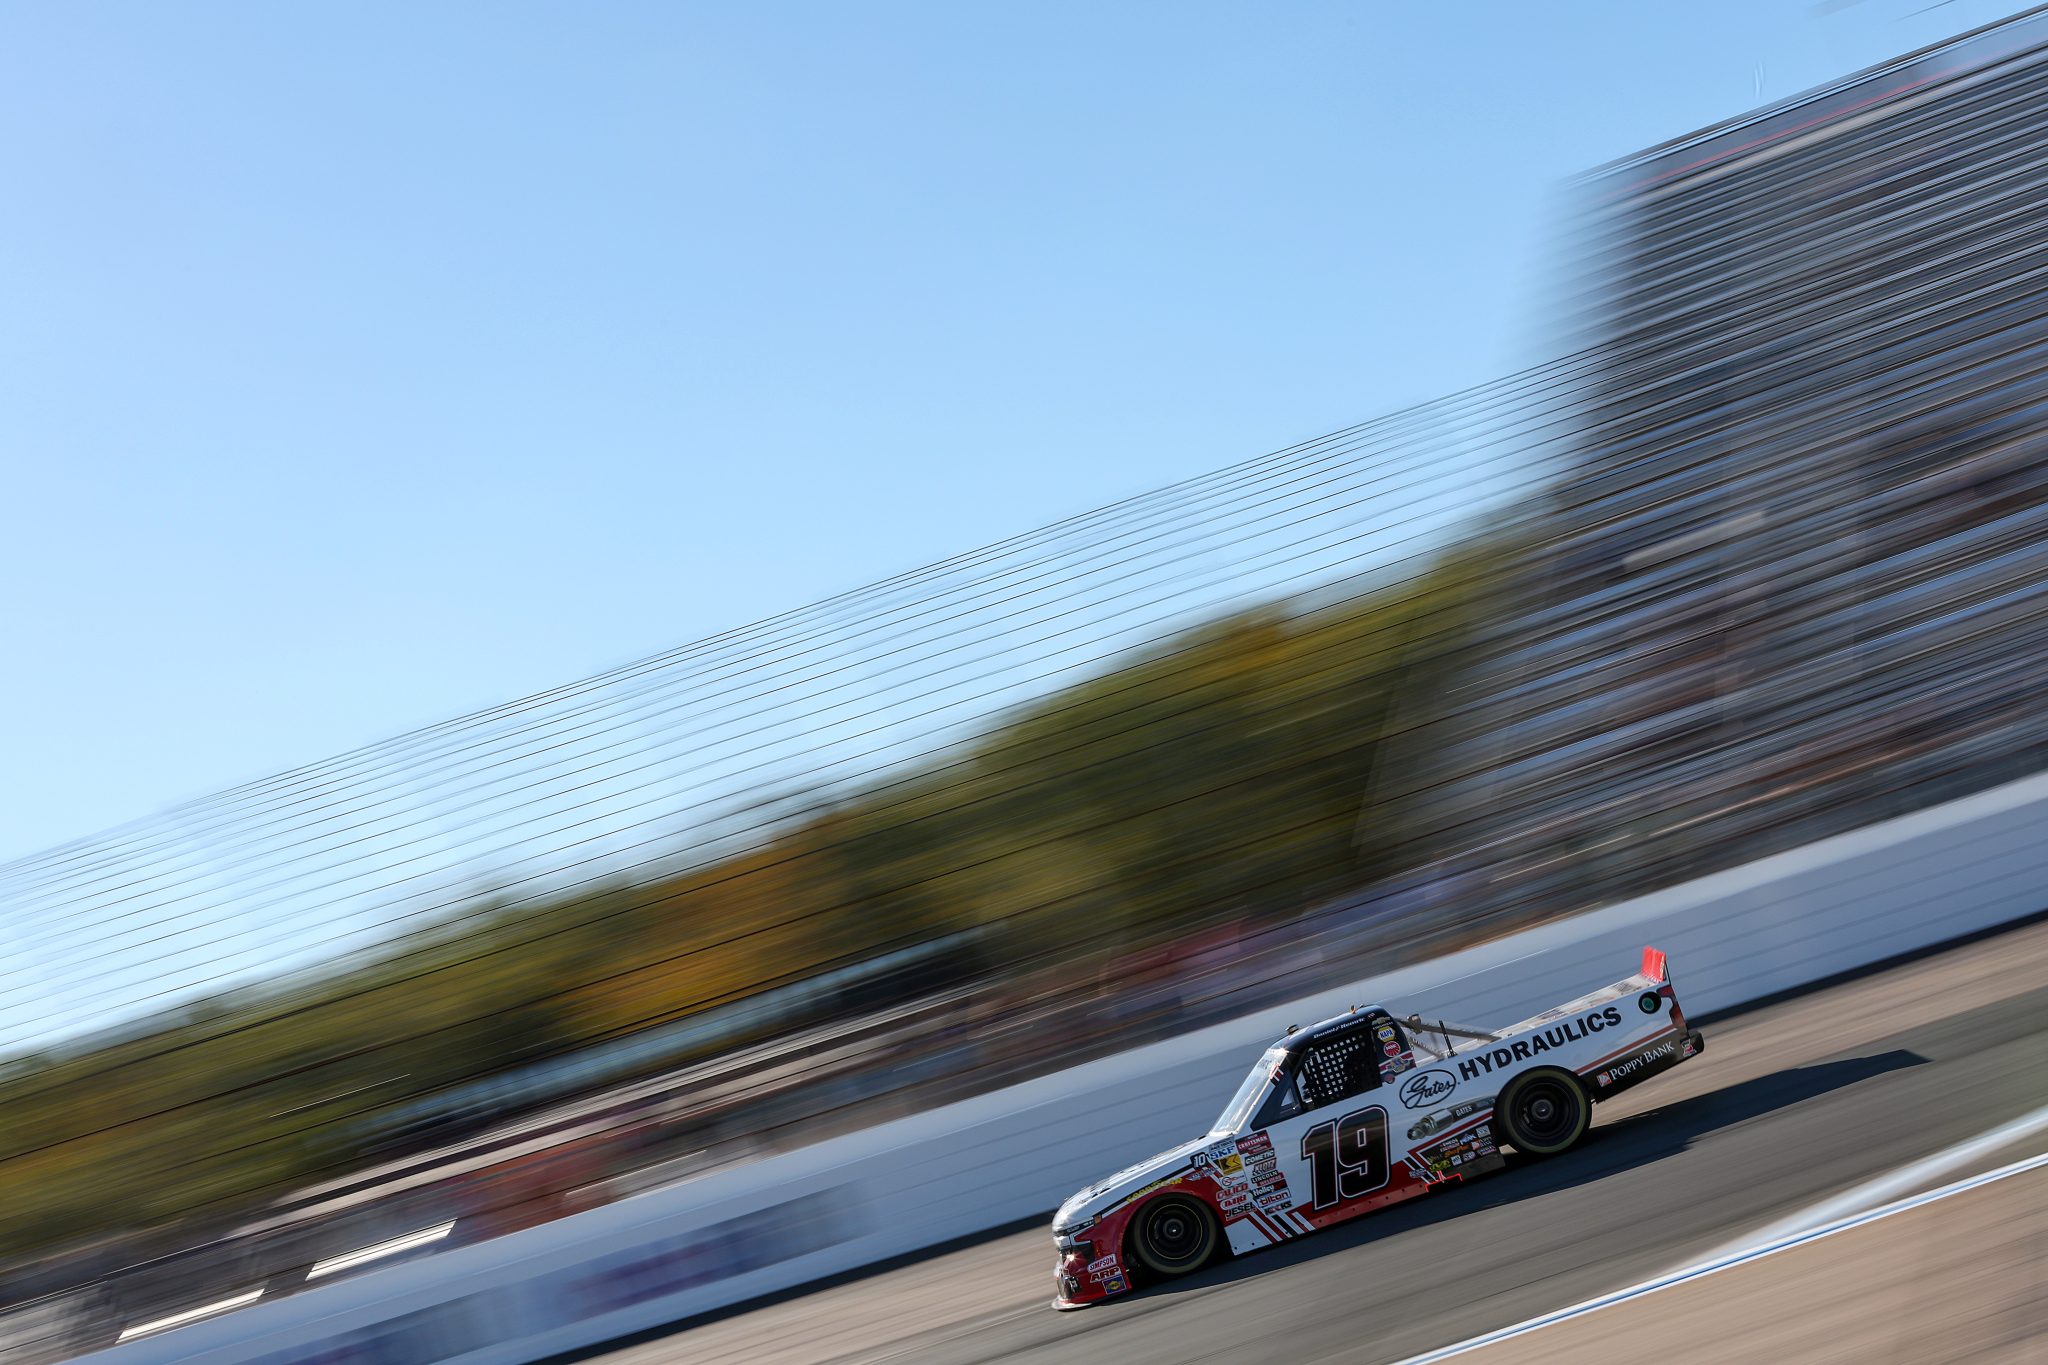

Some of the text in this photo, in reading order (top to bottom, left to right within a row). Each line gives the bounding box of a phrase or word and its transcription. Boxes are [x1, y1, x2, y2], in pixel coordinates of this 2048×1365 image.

[1340, 1018, 1366, 1029] Hemric
[1379, 1027, 1394, 1039] NAPA
[1457, 1007, 1622, 1081] HYDRAULICS
[1608, 1056, 1645, 1080] POPPY
[1643, 1041, 1675, 1063] BANK
[1403, 1076, 1453, 1109] Gates
[1455, 1104, 1473, 1117] GATES
[1238, 1136, 1268, 1150] CRAFTSMAN
[1209, 1145, 1236, 1160] SKF
[1245, 1150, 1275, 1164] COMETIC
[1301, 1104, 1392, 1212] 19
[1194, 1153, 1206, 1168] 10
[1252, 1169, 1279, 1183] LINCOLN
[1217, 1183, 1249, 1199] CALICO
[1253, 1184, 1275, 1197] Holley
[1227, 1202, 1255, 1217] JESEL
[1089, 1256, 1115, 1271] SIMPSON
[1091, 1266, 1121, 1281] ARP
